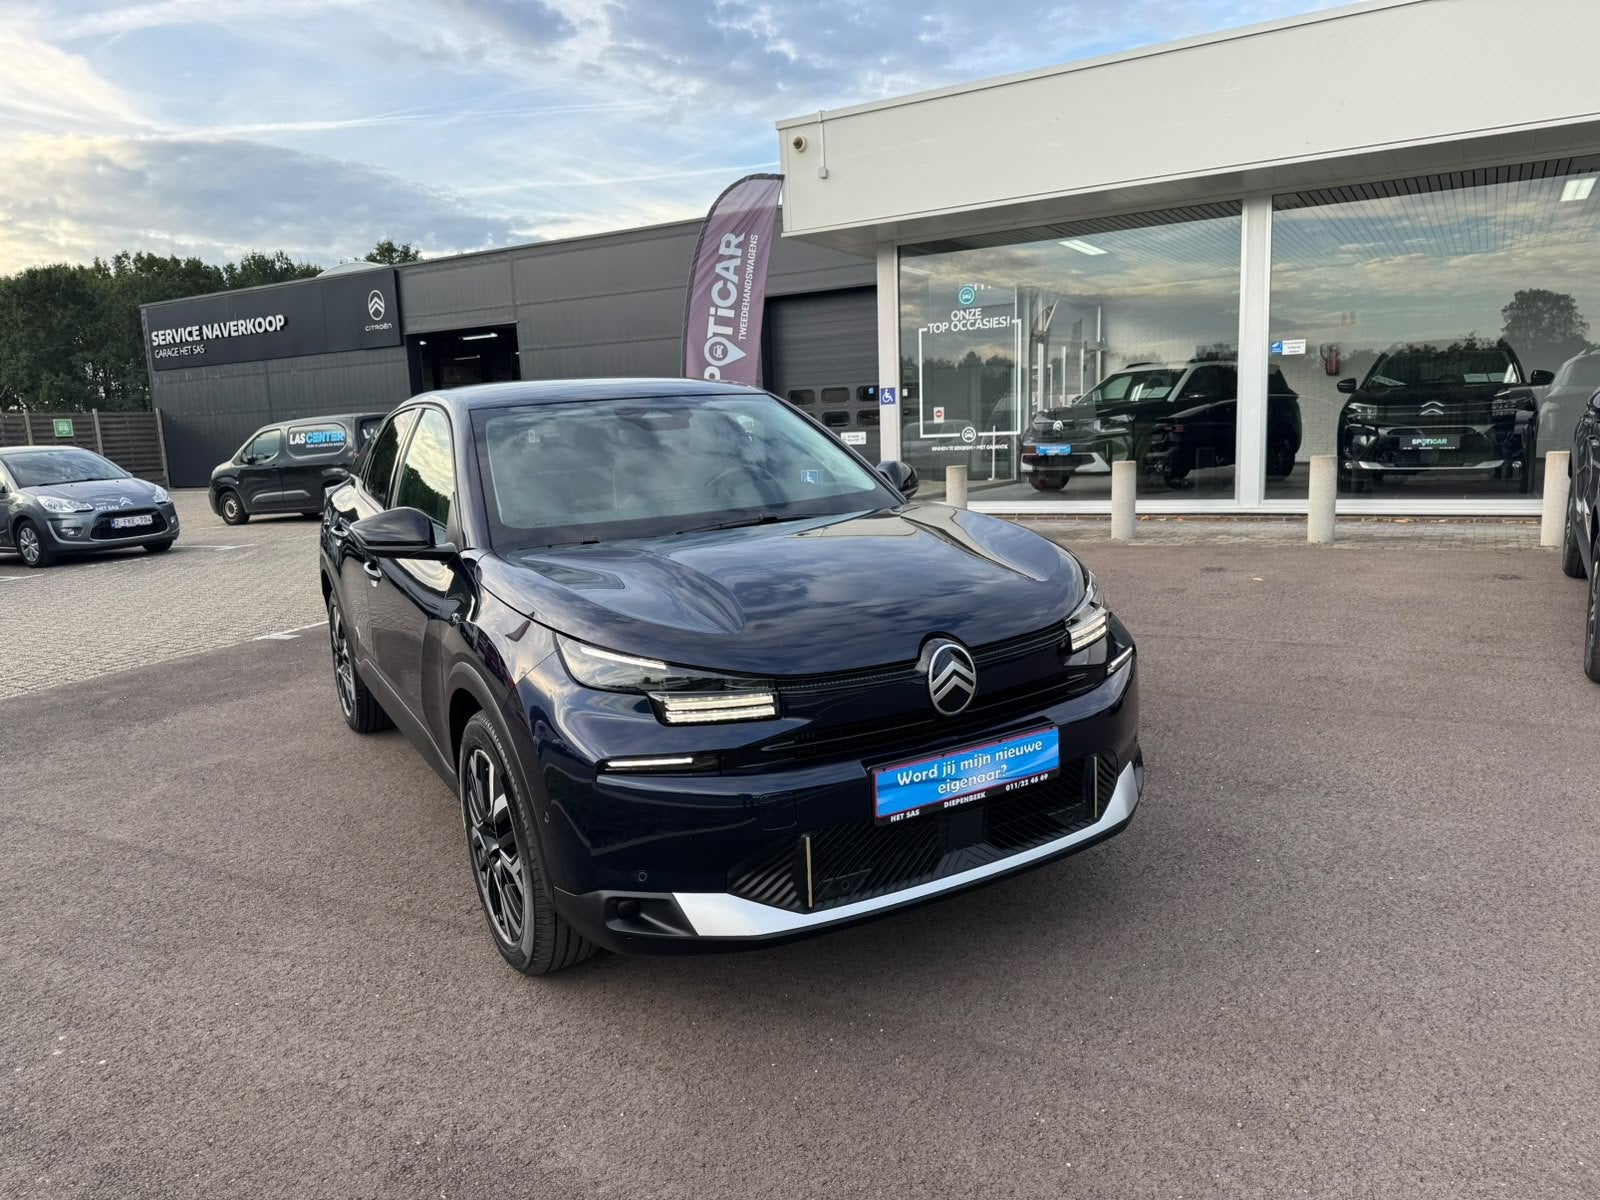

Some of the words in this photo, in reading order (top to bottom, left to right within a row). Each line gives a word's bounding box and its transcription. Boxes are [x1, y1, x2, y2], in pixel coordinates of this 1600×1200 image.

[739, 234, 759, 340] TWEEDEHANDSWAGENS
[928, 322, 949, 334] TOP
[951, 316, 1010, 332] OCCASIES!
[951, 308, 982, 321] ONZE
[151, 325, 201, 347] SERVICE
[202, 314, 285, 340] NAVERKOOP
[154, 347, 179, 359] GARAGE
[179, 346, 192, 356] HET
[192, 344, 205, 355] SAS
[289, 432, 306, 445] LAS
[306, 430, 346, 444] CENTER
[897, 763, 938, 786] Word
[942, 760, 956, 778] jij
[960, 752, 991, 770] mijn
[995, 740, 1043, 761] nieuwe
[937, 764, 1008, 795] eigenaar?
[890, 813, 905, 823] HET
[906, 808, 920, 819] SAS
[943, 791, 986, 808] DIEPENBEEK
[1005, 778, 1029, 791] 011/22
